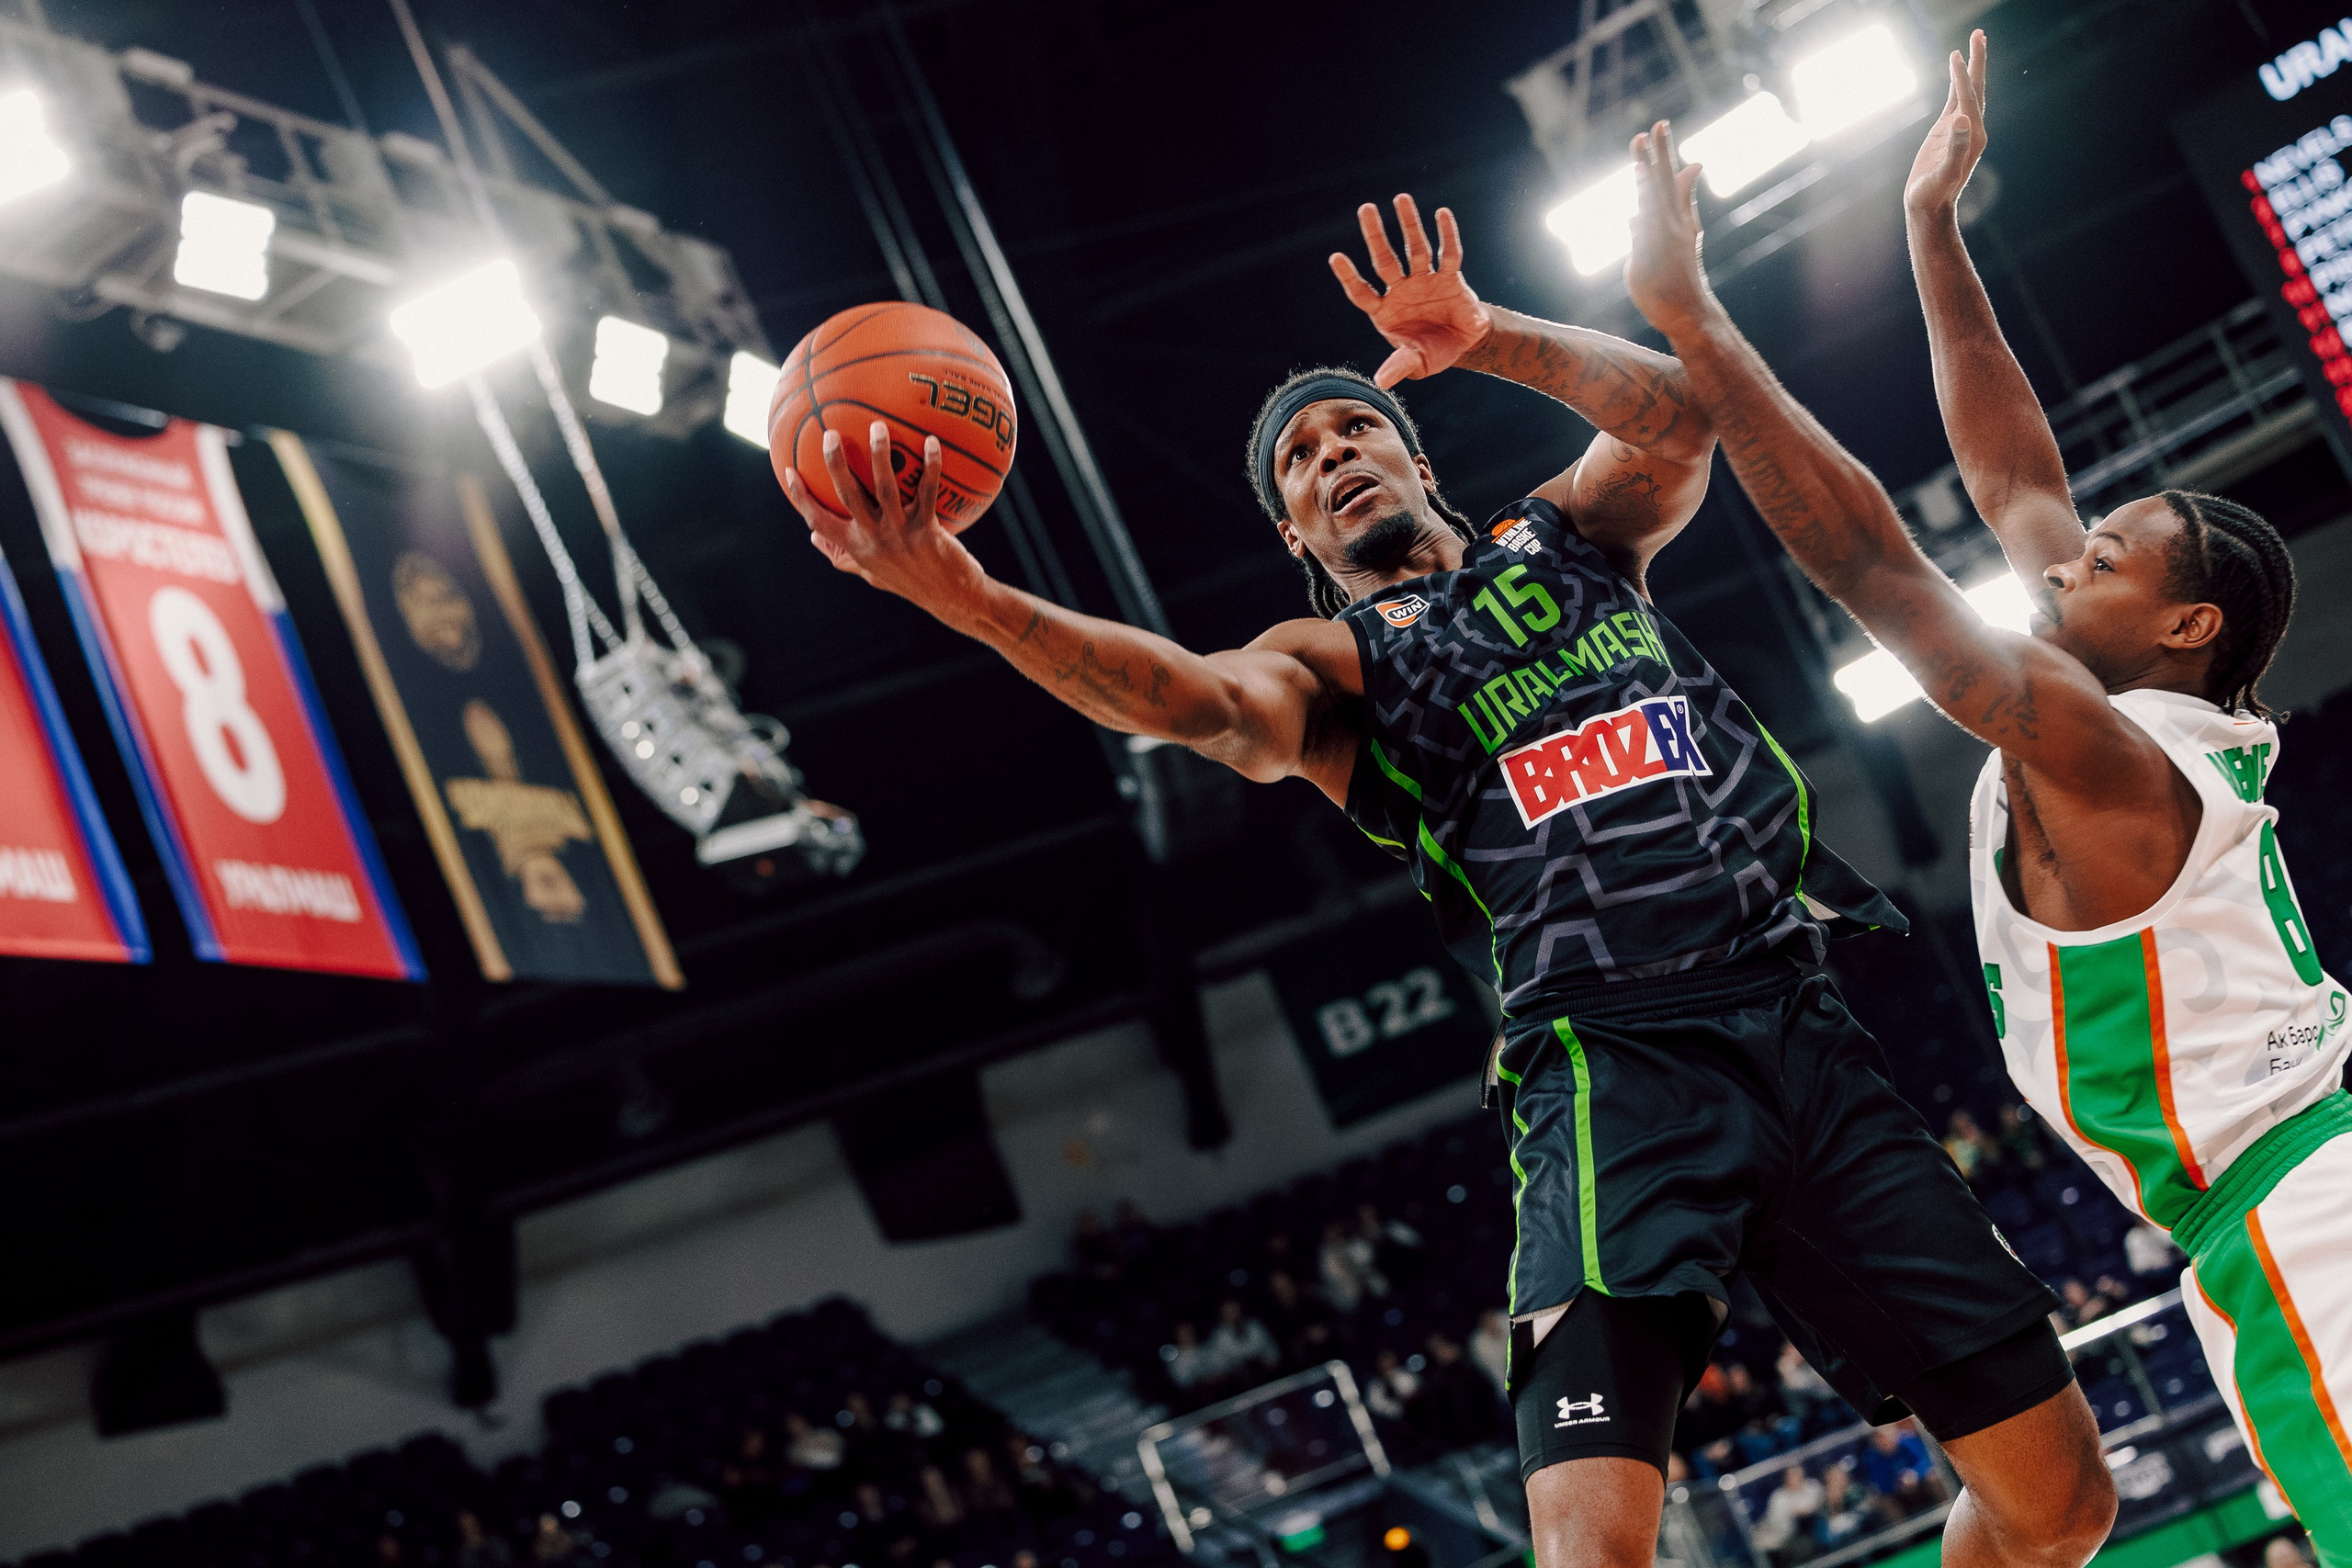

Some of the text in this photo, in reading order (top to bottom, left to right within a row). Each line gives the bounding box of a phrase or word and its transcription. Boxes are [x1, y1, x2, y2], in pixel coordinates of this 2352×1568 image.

[909, 371, 1014, 452] ÖGEL
[1496, 519, 1532, 547] WINLINE
[1507, 526, 1538, 553] BASKE
[1523, 538, 1543, 555] CUP
[1392, 601, 1422, 619] WIN
[1473, 563, 1561, 649] 15
[150, 586, 287, 824] 8
[1457, 611, 1673, 754] URALMASH
[1503, 700, 1707, 822] BROZEX
[1317, 967, 1455, 1057] B22
[2267, 1025, 2318, 1051] Ак Барс
[1555, 1419, 1577, 1428] UNDER
